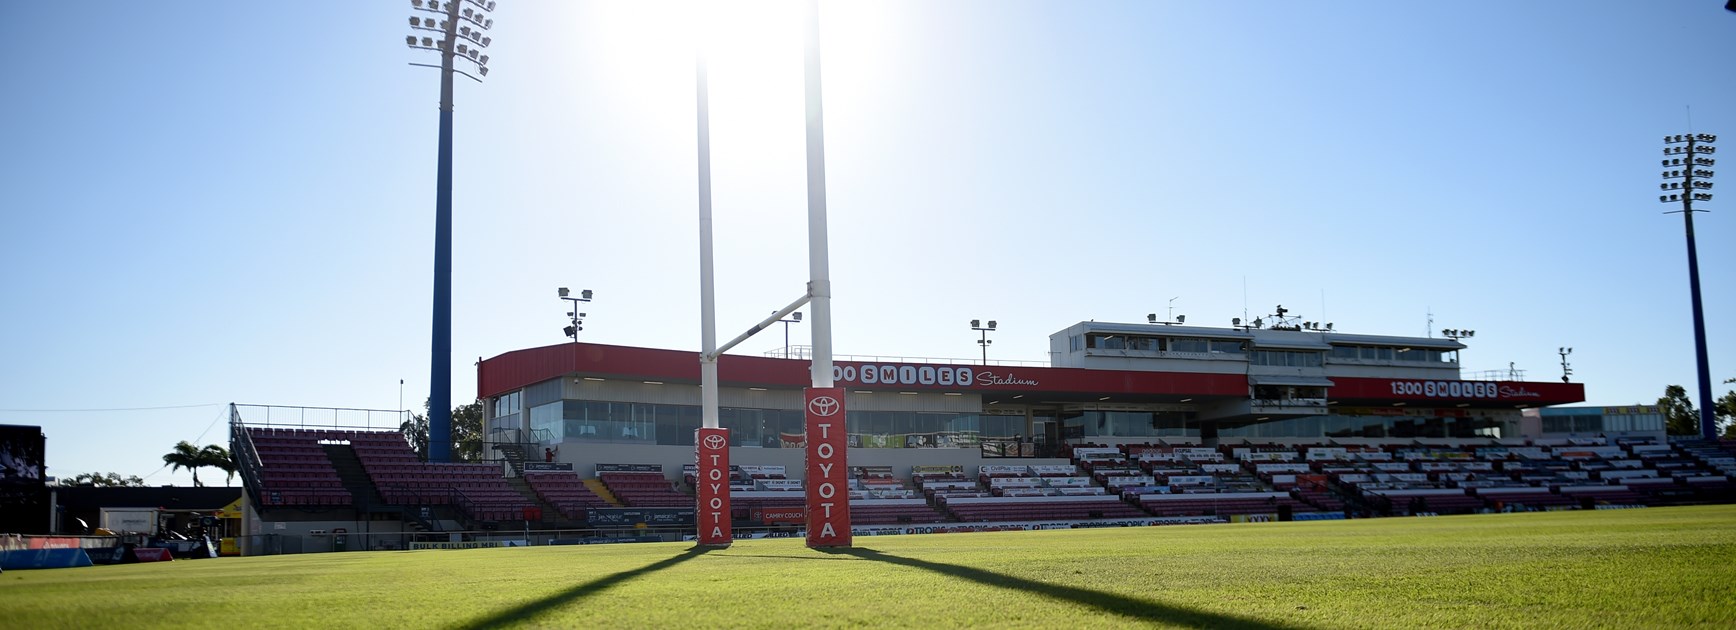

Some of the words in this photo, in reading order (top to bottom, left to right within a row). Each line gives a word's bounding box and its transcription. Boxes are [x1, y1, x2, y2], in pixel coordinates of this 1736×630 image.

[808, 364, 857, 382] 00
[861, 365, 973, 385] SMILES
[976, 371, 1039, 386] Stadium
[1390, 381, 1422, 395] 1300
[1424, 381, 1498, 398] SMILES
[1498, 385, 1541, 398] Stadium
[709, 454, 723, 538] TOYOTA
[818, 423, 836, 538] TOYOTA
